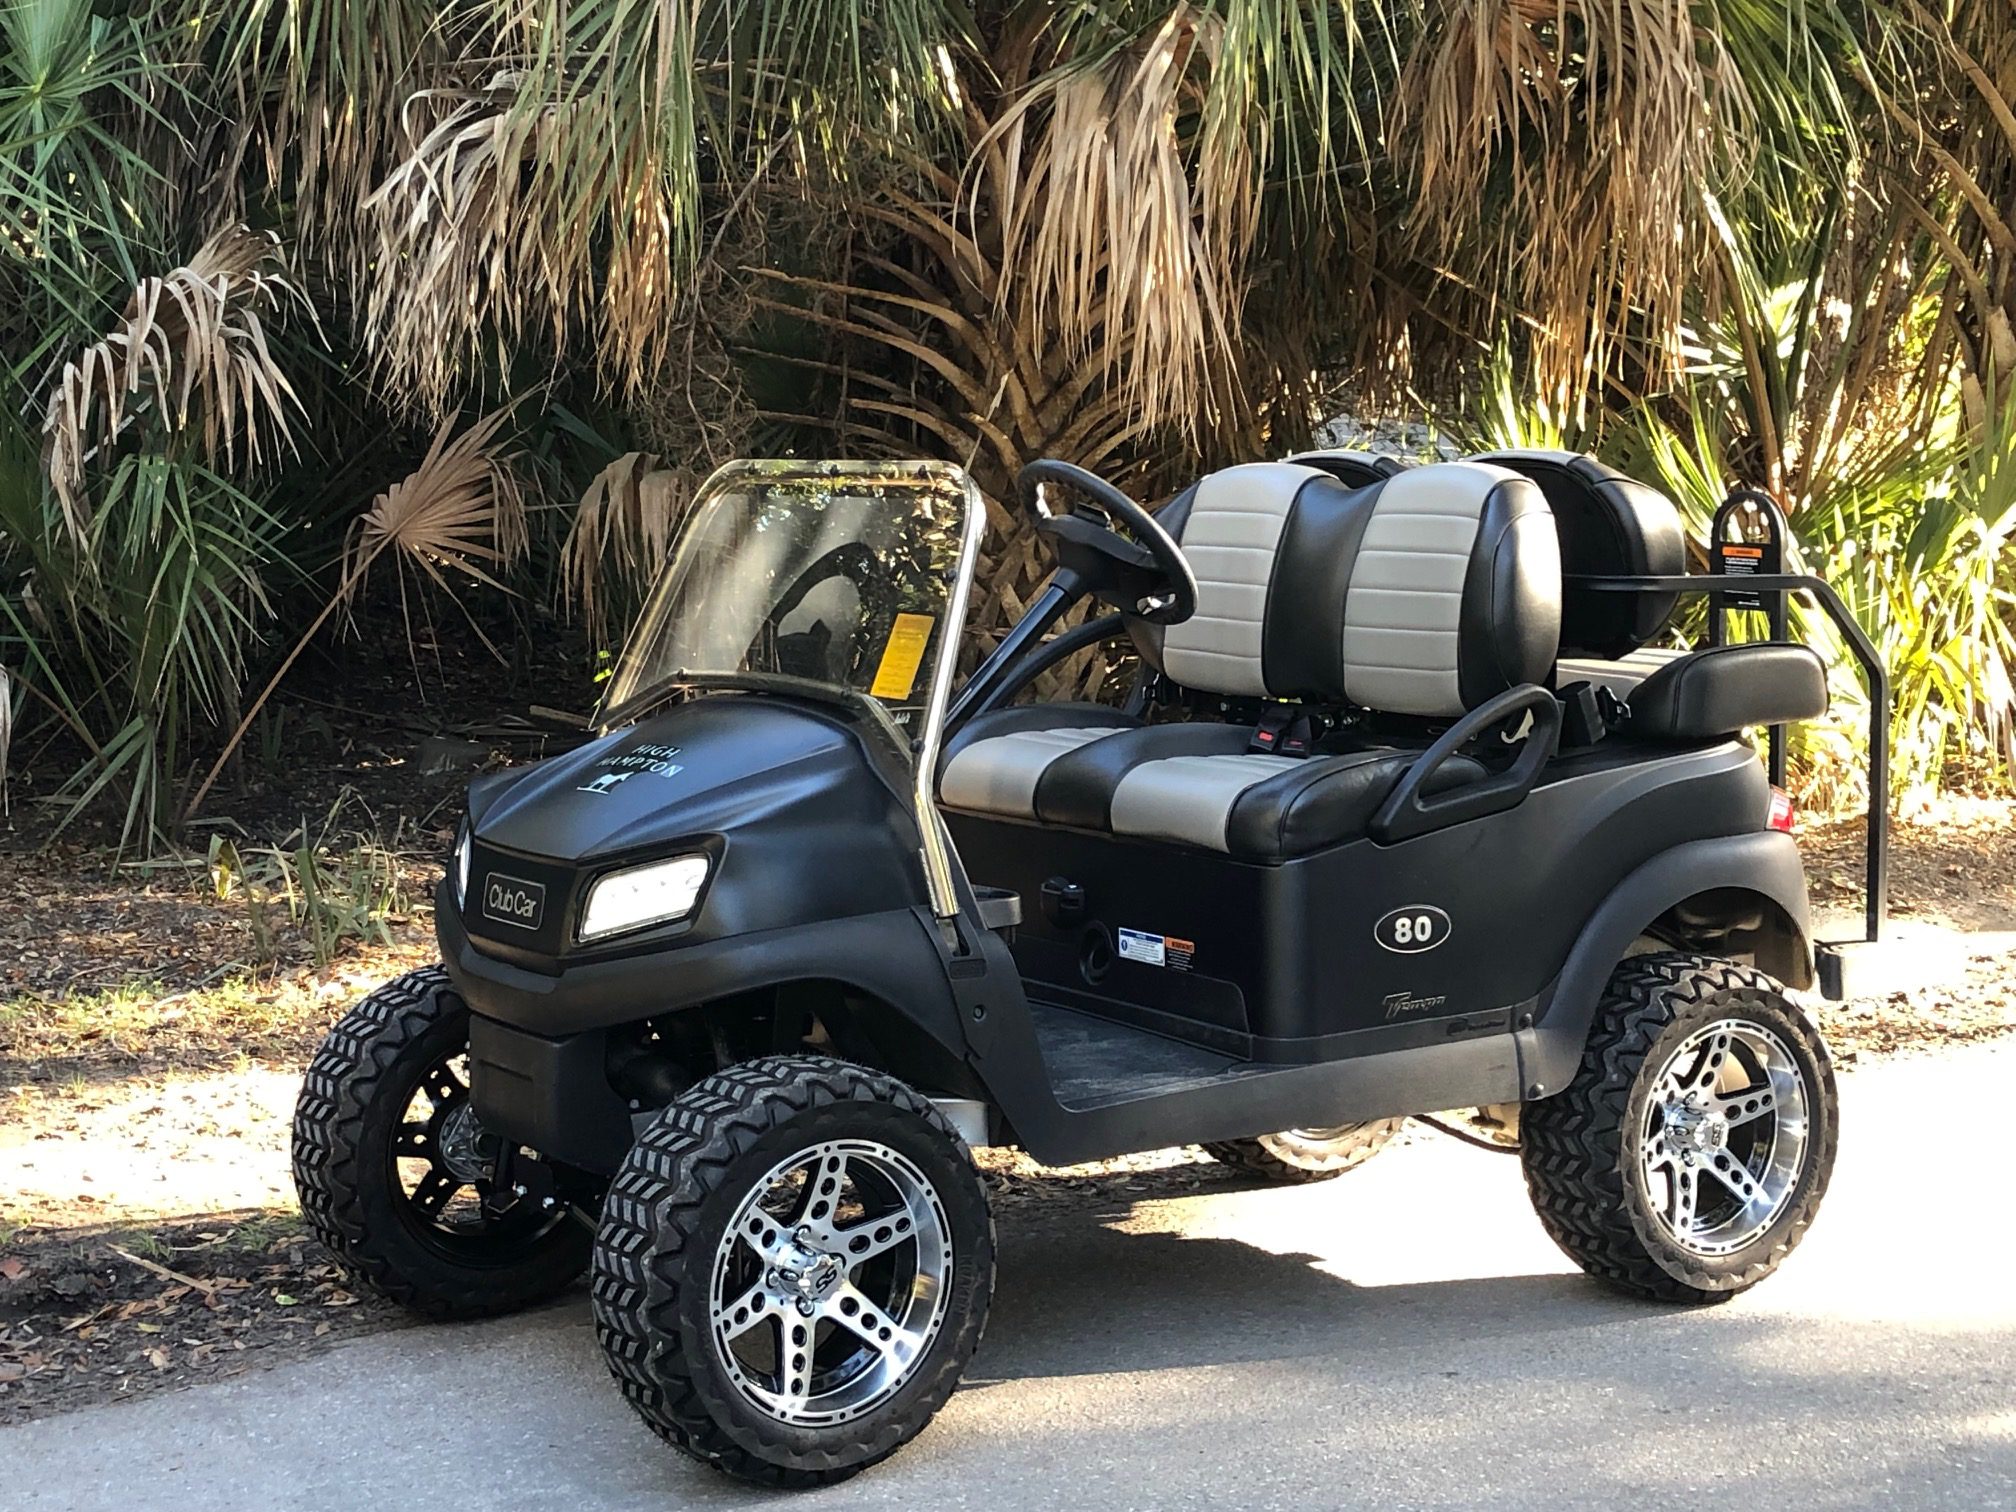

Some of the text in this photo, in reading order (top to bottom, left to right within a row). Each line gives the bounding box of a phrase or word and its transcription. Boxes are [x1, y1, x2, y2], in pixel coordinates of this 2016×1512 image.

[632, 744, 681, 759] HIGH
[596, 756, 685, 778] HAMPTON
[1394, 915, 1432, 943] 80
